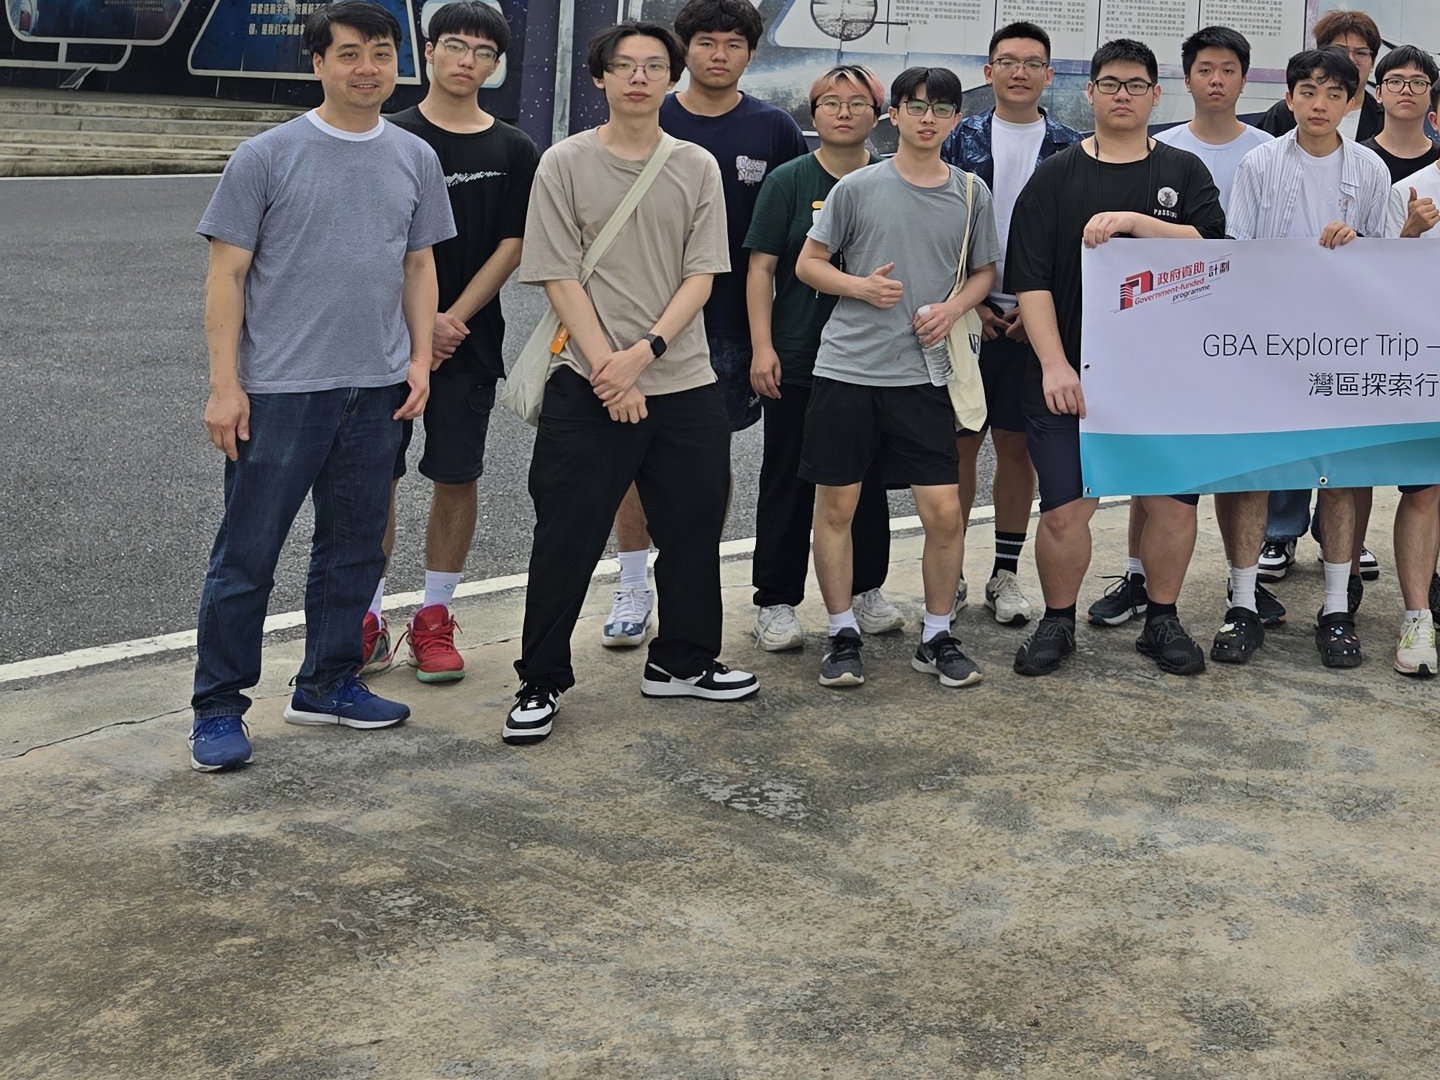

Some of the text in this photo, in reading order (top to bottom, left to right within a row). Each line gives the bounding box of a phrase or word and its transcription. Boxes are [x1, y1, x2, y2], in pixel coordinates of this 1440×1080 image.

[1157, 260, 1230, 286] 政府資助 計劃
[1134, 277, 1205, 306] Government-funded
[1172, 284, 1211, 302] programme
[1203, 333, 1258, 357] GBA
[1266, 332, 1369, 361] Explorer
[1375, 332, 1419, 361] Trip
[1308, 372, 1439, 397] 灣區探索行
